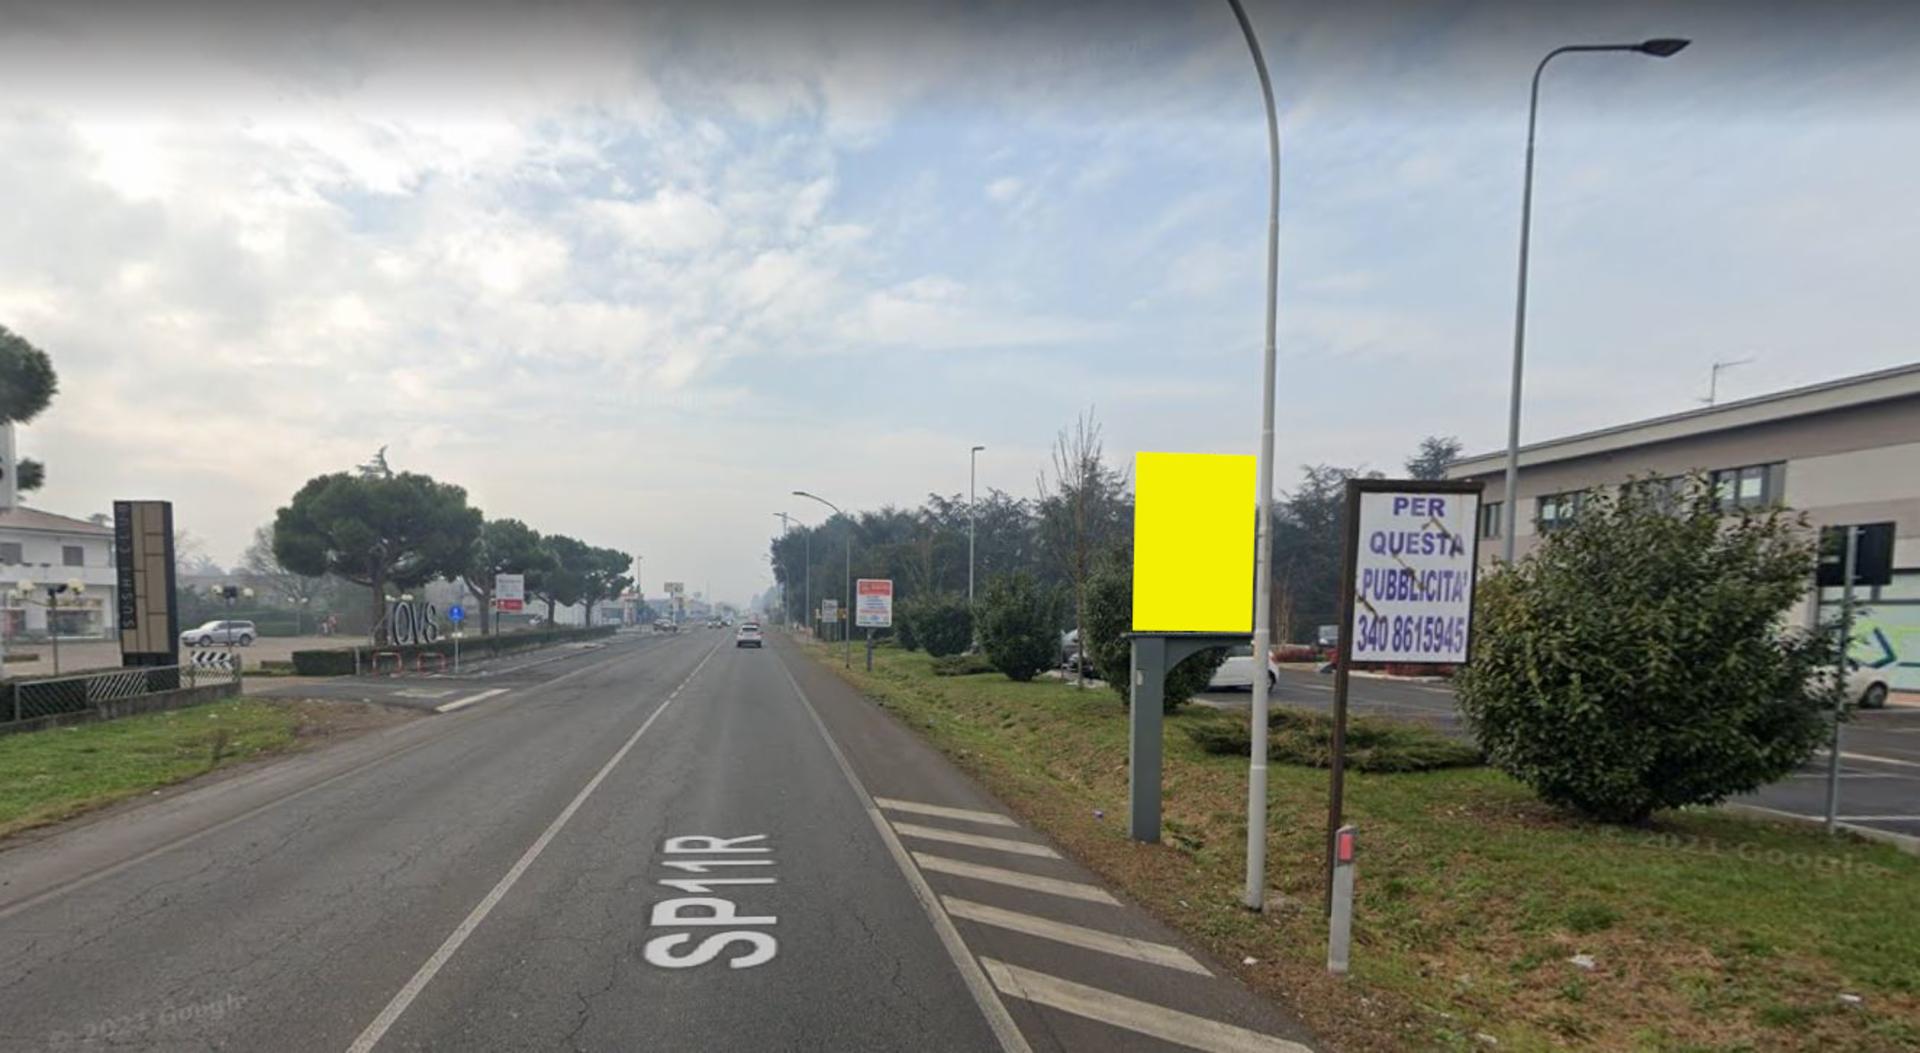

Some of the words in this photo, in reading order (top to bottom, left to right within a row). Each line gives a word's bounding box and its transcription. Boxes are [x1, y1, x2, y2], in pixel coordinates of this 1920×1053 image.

[1393, 497, 1445, 517] PER
[1369, 531, 1465, 557] QUESTA
[119, 566, 135, 629] SUSHI
[1362, 568, 1467, 602] PUBBLICITA'
[393, 602, 438, 645] OVS
[1357, 615, 1388, 652] 340
[1392, 615, 1464, 653] 8615945
[644, 834, 778, 969] SP11R
